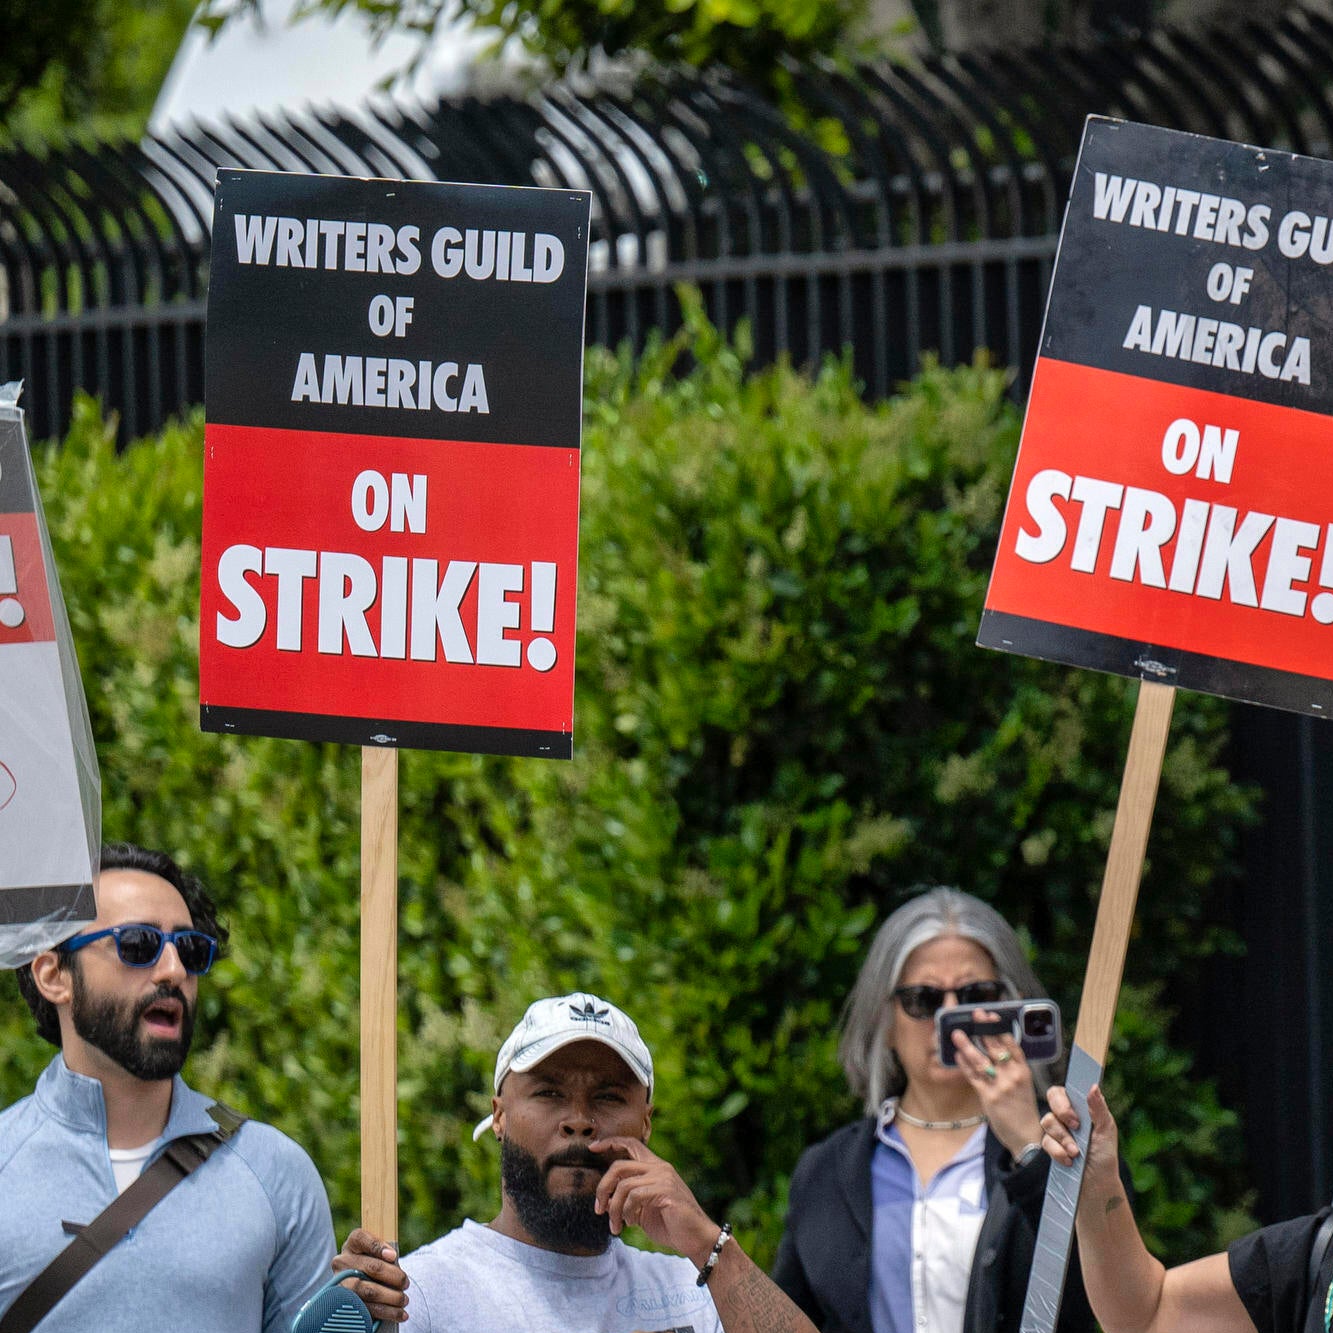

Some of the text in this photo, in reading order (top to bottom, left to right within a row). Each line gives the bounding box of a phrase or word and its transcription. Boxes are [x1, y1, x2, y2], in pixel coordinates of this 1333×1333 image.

[1094, 173, 1270, 251] WRITERS
[234, 213, 565, 284] WRITERS GUILD
[368, 294, 414, 338] OF
[1207, 262, 1253, 305] OF
[1123, 304, 1311, 385] AMERICA
[291, 352, 490, 415] AMERICA
[1161, 418, 1240, 484] ON
[351, 470, 428, 535] ON
[215, 543, 558, 672] STRIKE!
